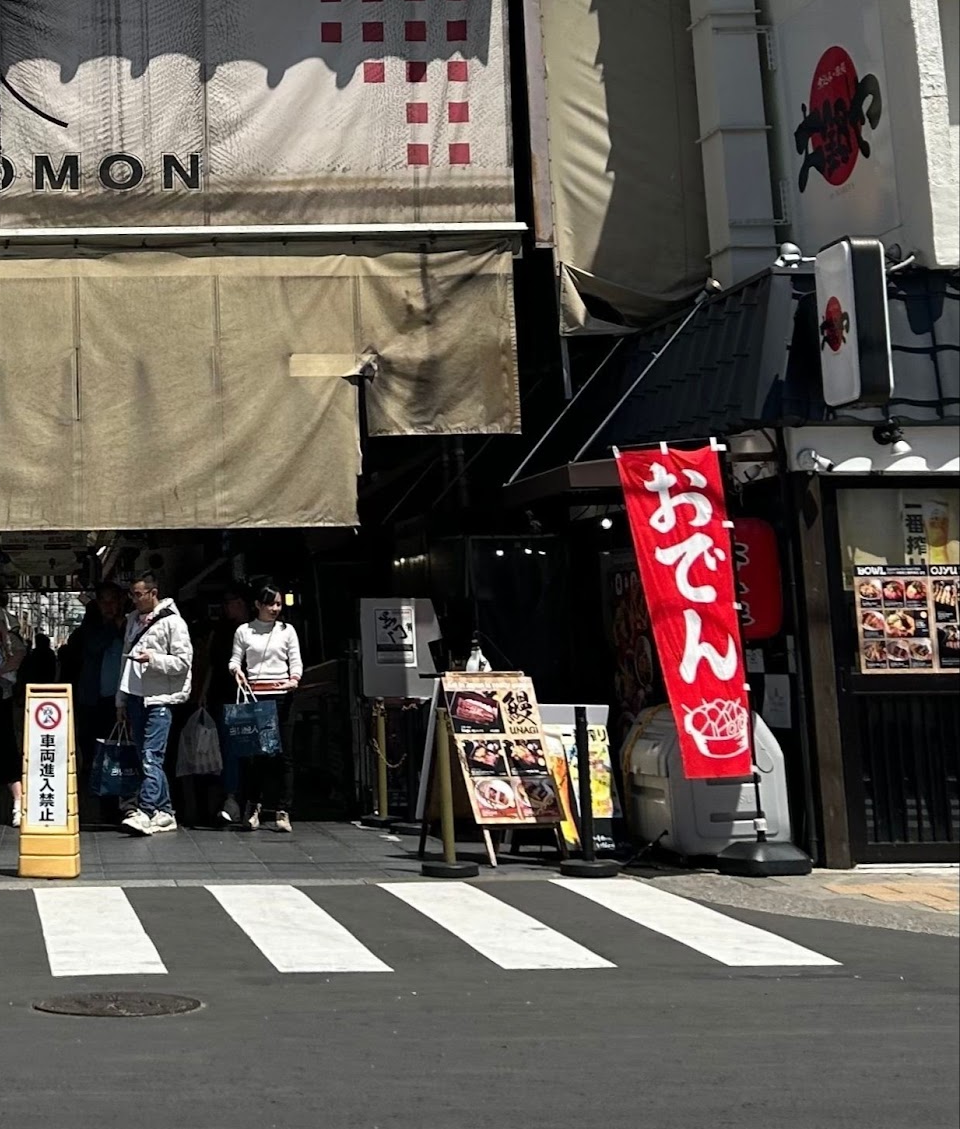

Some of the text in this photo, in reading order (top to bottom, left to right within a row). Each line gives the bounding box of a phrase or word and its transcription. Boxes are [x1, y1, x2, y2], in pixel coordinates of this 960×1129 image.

[644, 462, 738, 684] おでん
[856, 566, 887, 575] BOWL
[502, 691, 537, 724] 鰻
[39, 734, 55, 821] 車両進入禁止
